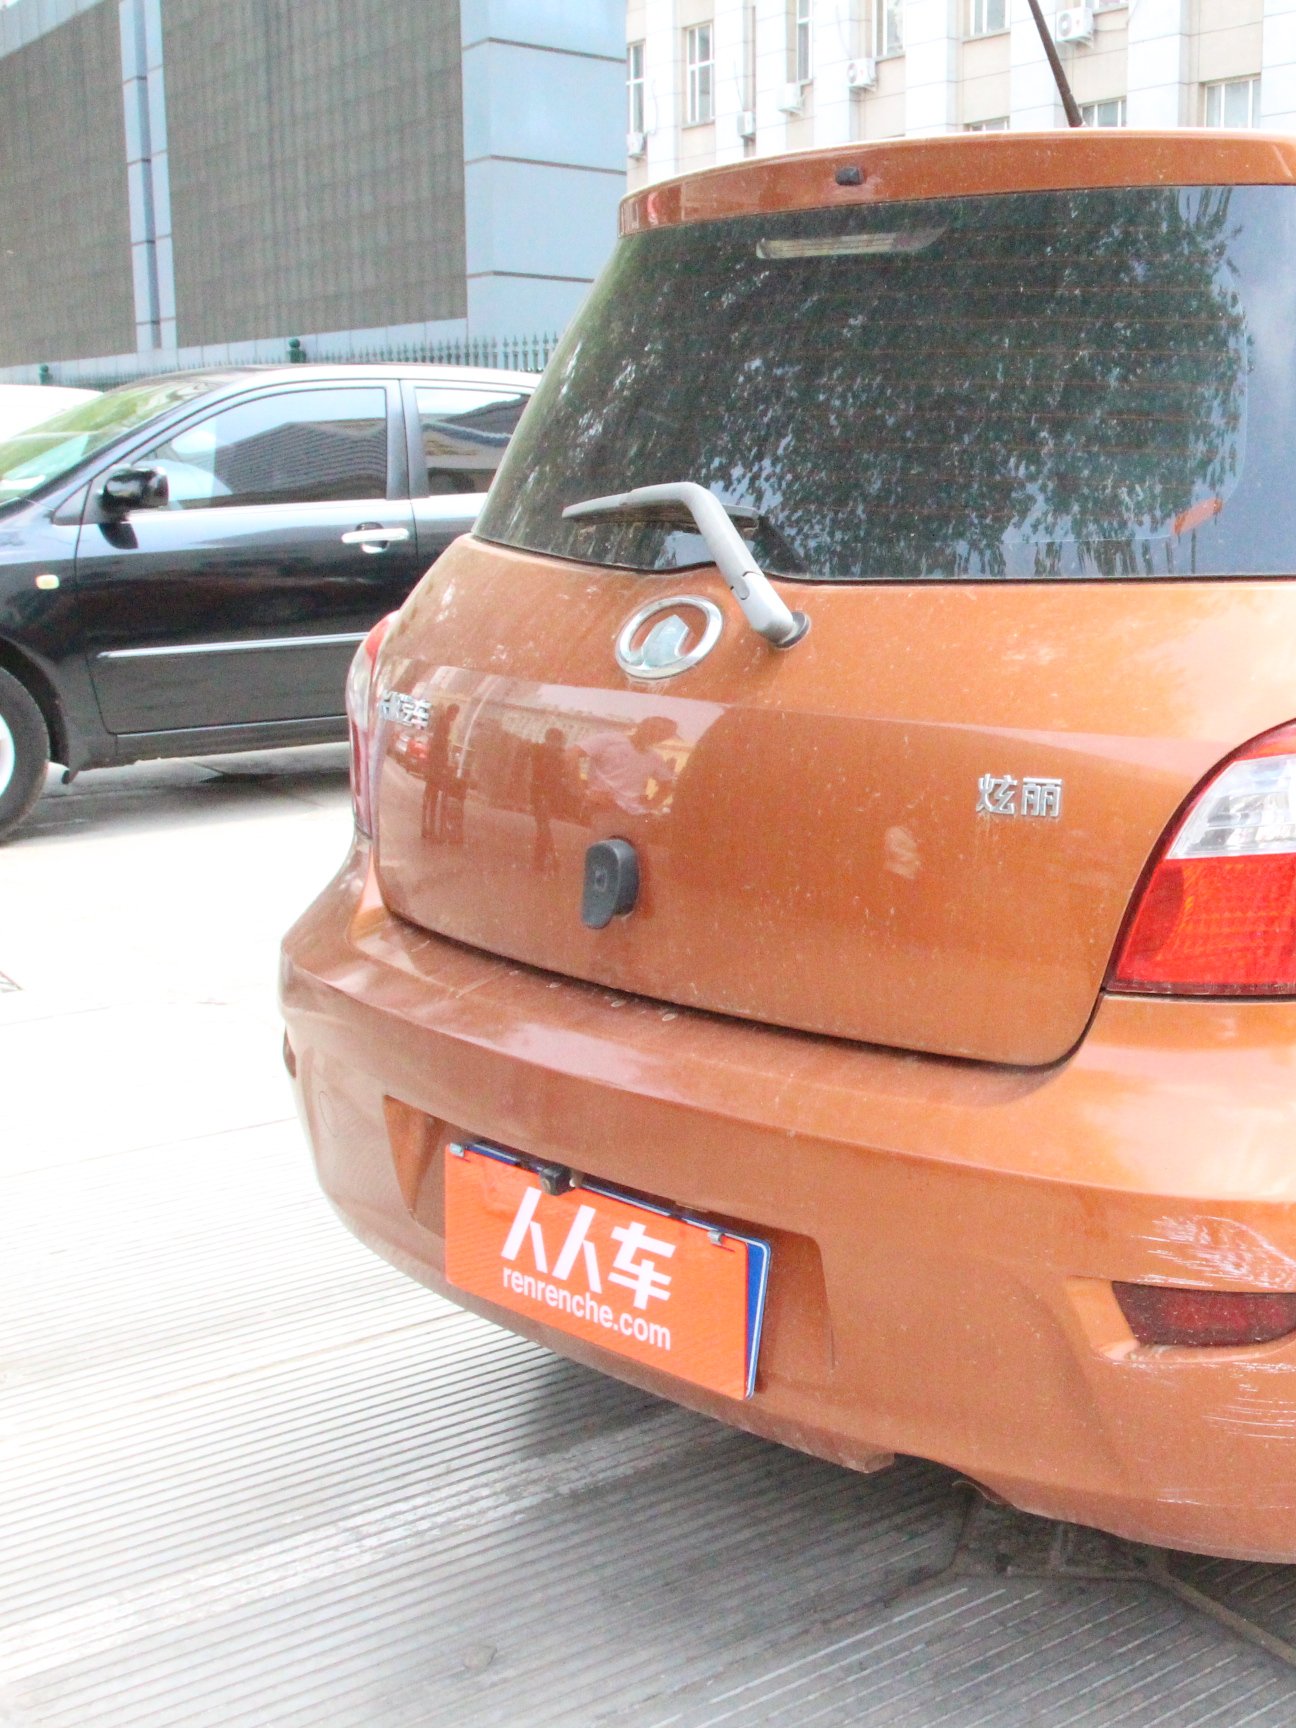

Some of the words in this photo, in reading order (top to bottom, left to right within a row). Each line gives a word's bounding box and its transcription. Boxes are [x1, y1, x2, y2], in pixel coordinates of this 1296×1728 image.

[975, 773, 1062, 817] 炫丽
[500, 1186, 677, 1311] 人人车
[502, 1266, 672, 1351] renrenche.com
